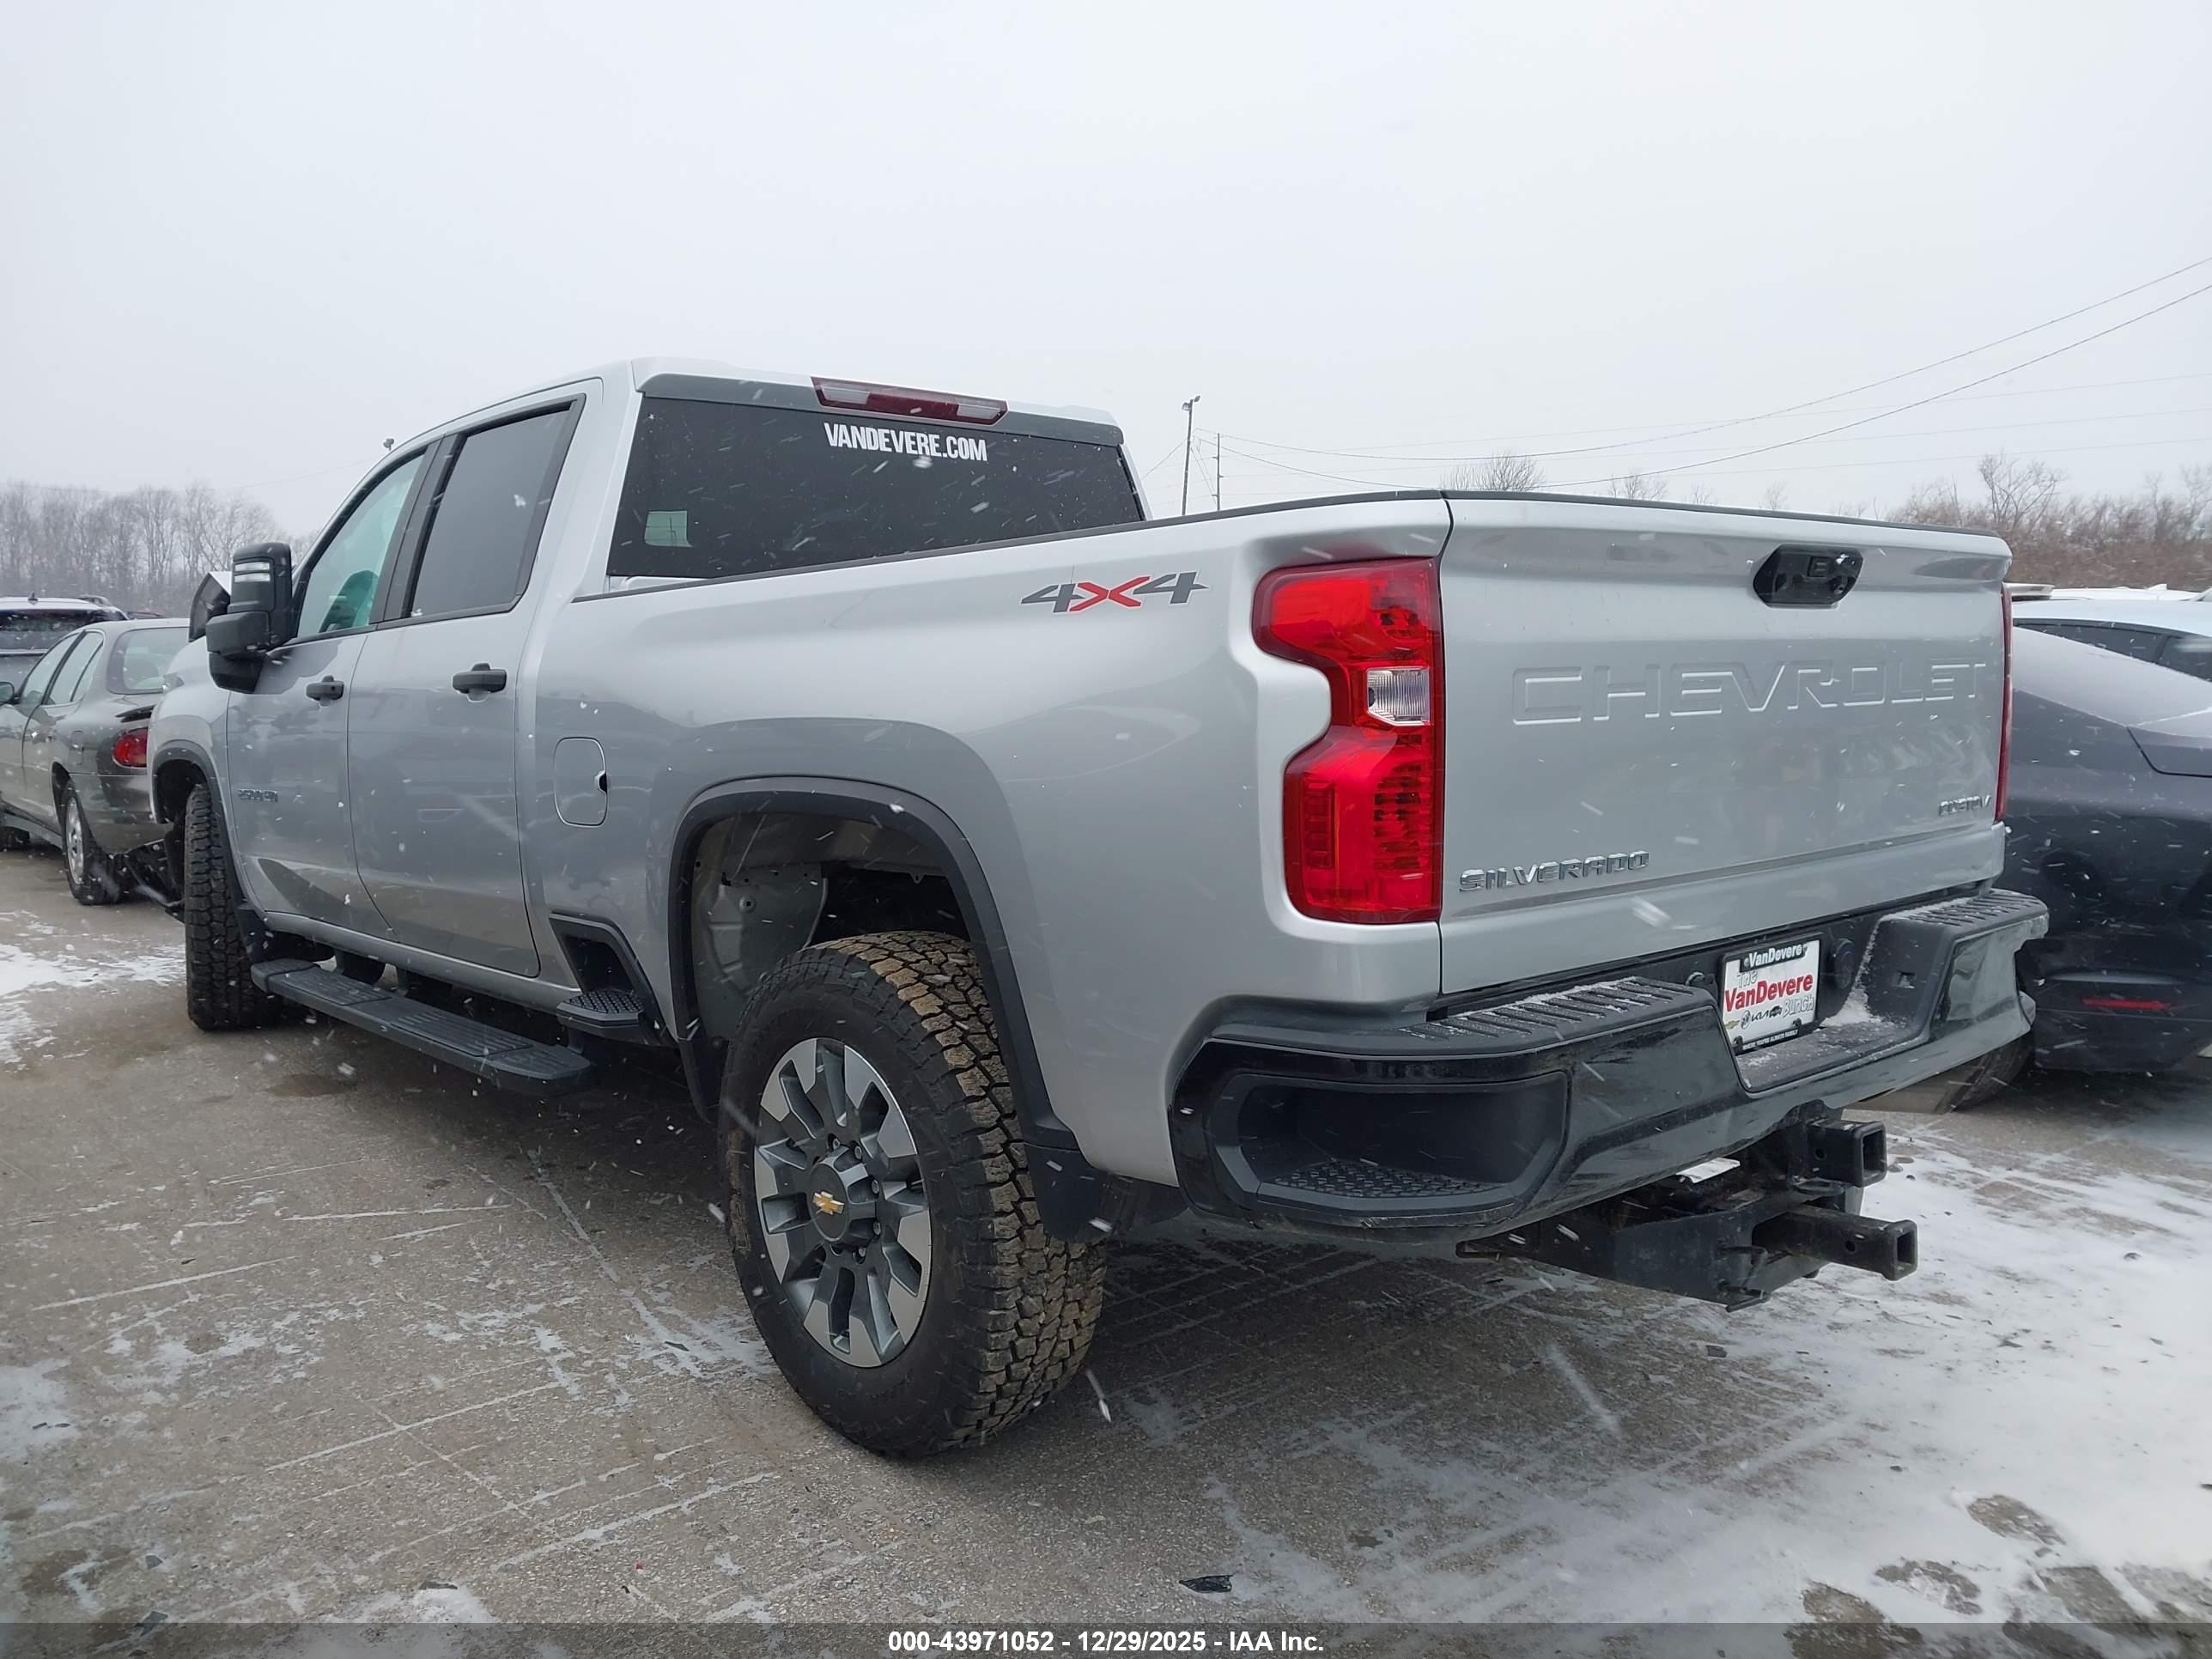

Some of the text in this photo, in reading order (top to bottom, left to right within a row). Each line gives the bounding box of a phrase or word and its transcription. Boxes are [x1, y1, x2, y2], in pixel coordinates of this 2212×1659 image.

[823, 422, 988, 462] VANDEVERE.COM
[1512, 659, 1986, 726] CHEVROLET
[1459, 850, 1650, 892] SILVERADO
[1748, 945, 1802, 967] VanDevere
[1724, 974, 1814, 1012] VanDevere
